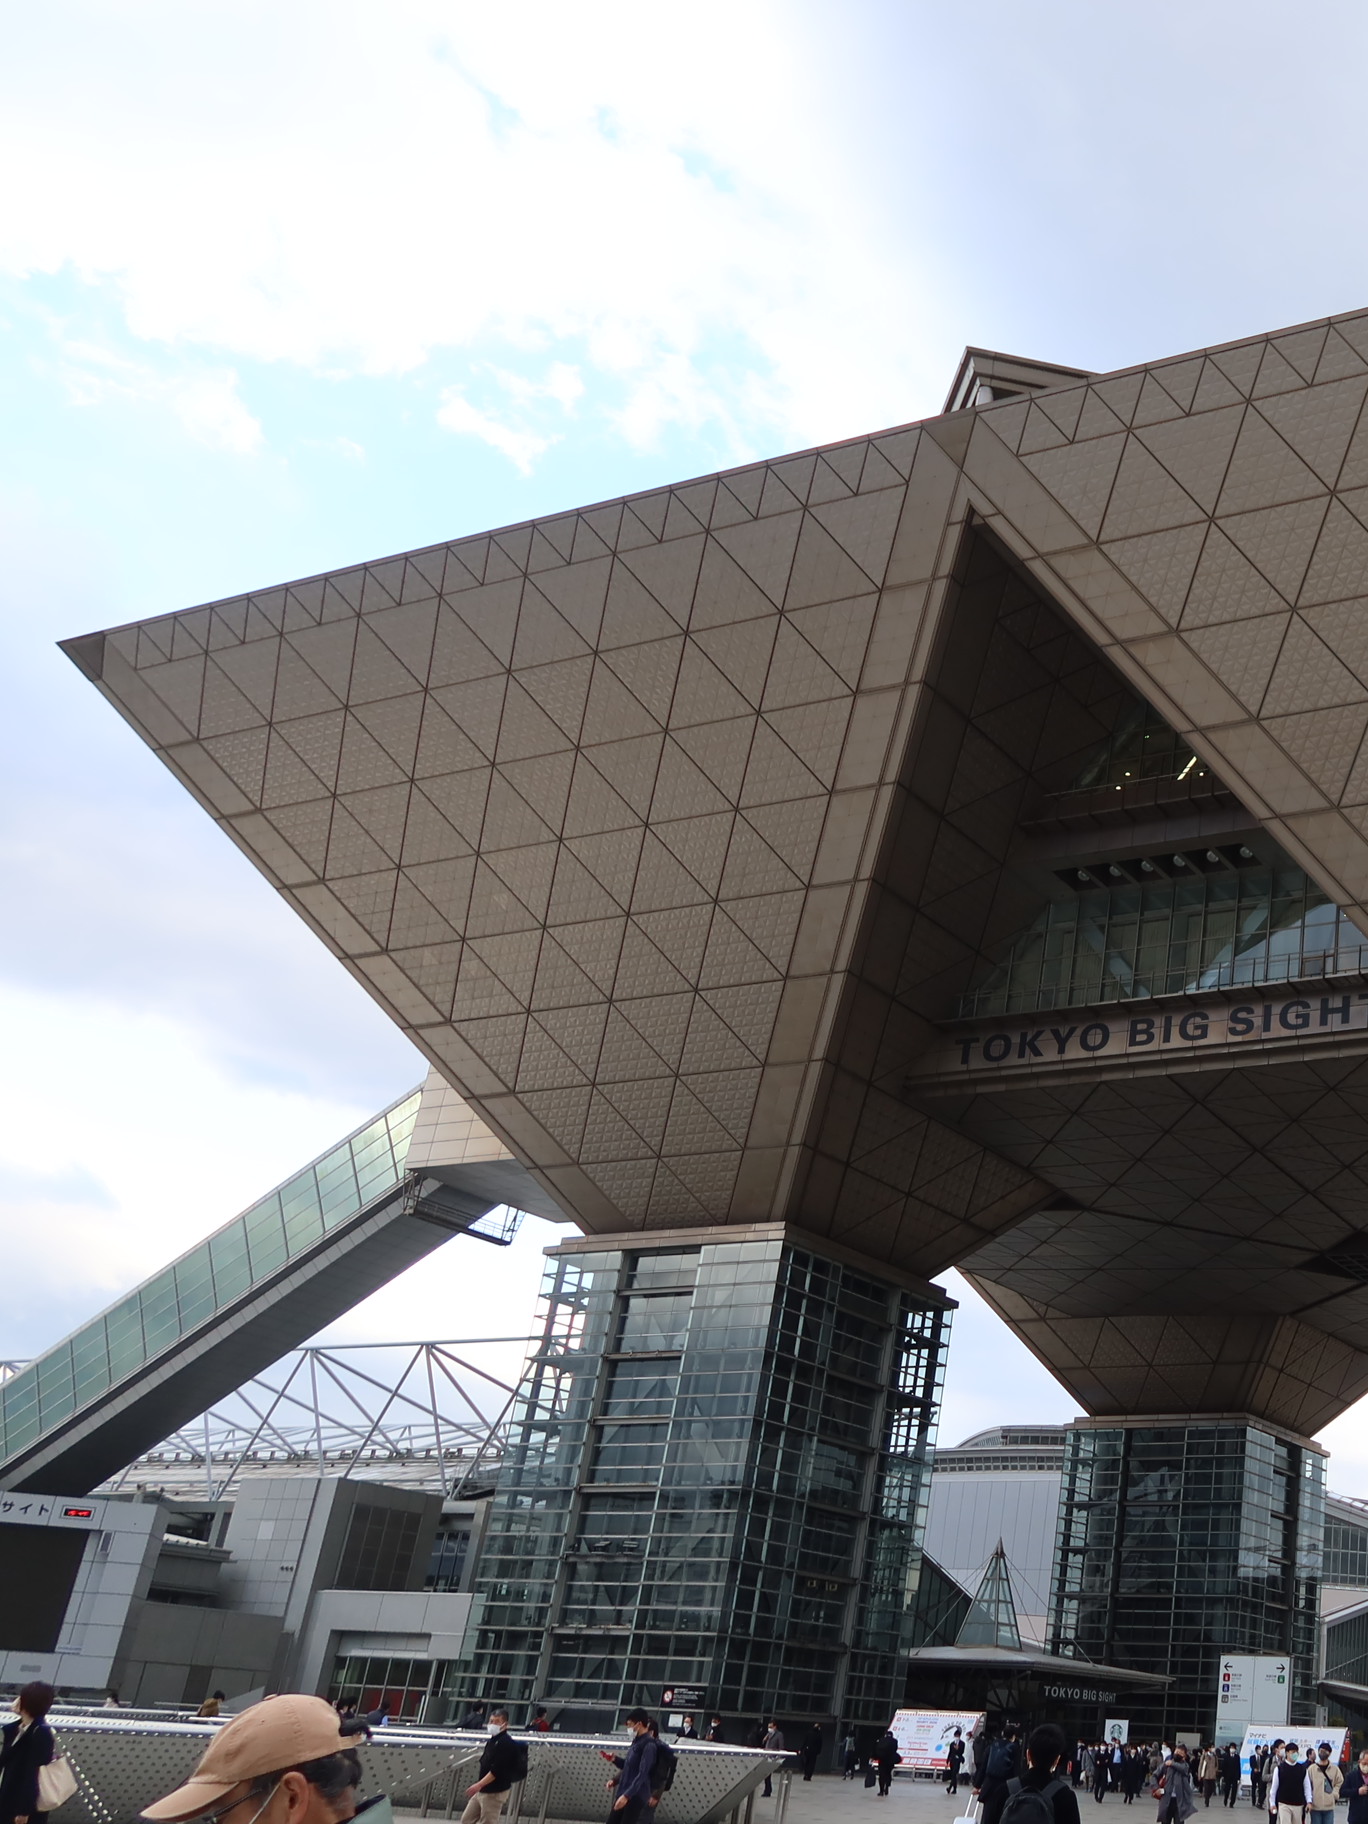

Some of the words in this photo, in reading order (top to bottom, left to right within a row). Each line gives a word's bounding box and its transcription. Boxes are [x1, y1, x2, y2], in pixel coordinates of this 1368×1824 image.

[955, 1022, 1110, 1065] TOKYO
[1128, 1012, 1209, 1048] BIG
[2, 1501, 49, 1516] サイト
[1043, 1685, 1080, 1699] TOKYO
[1082, 1689, 1097, 1701] BIG
[1098, 1691, 1116, 1703] SIGHT
